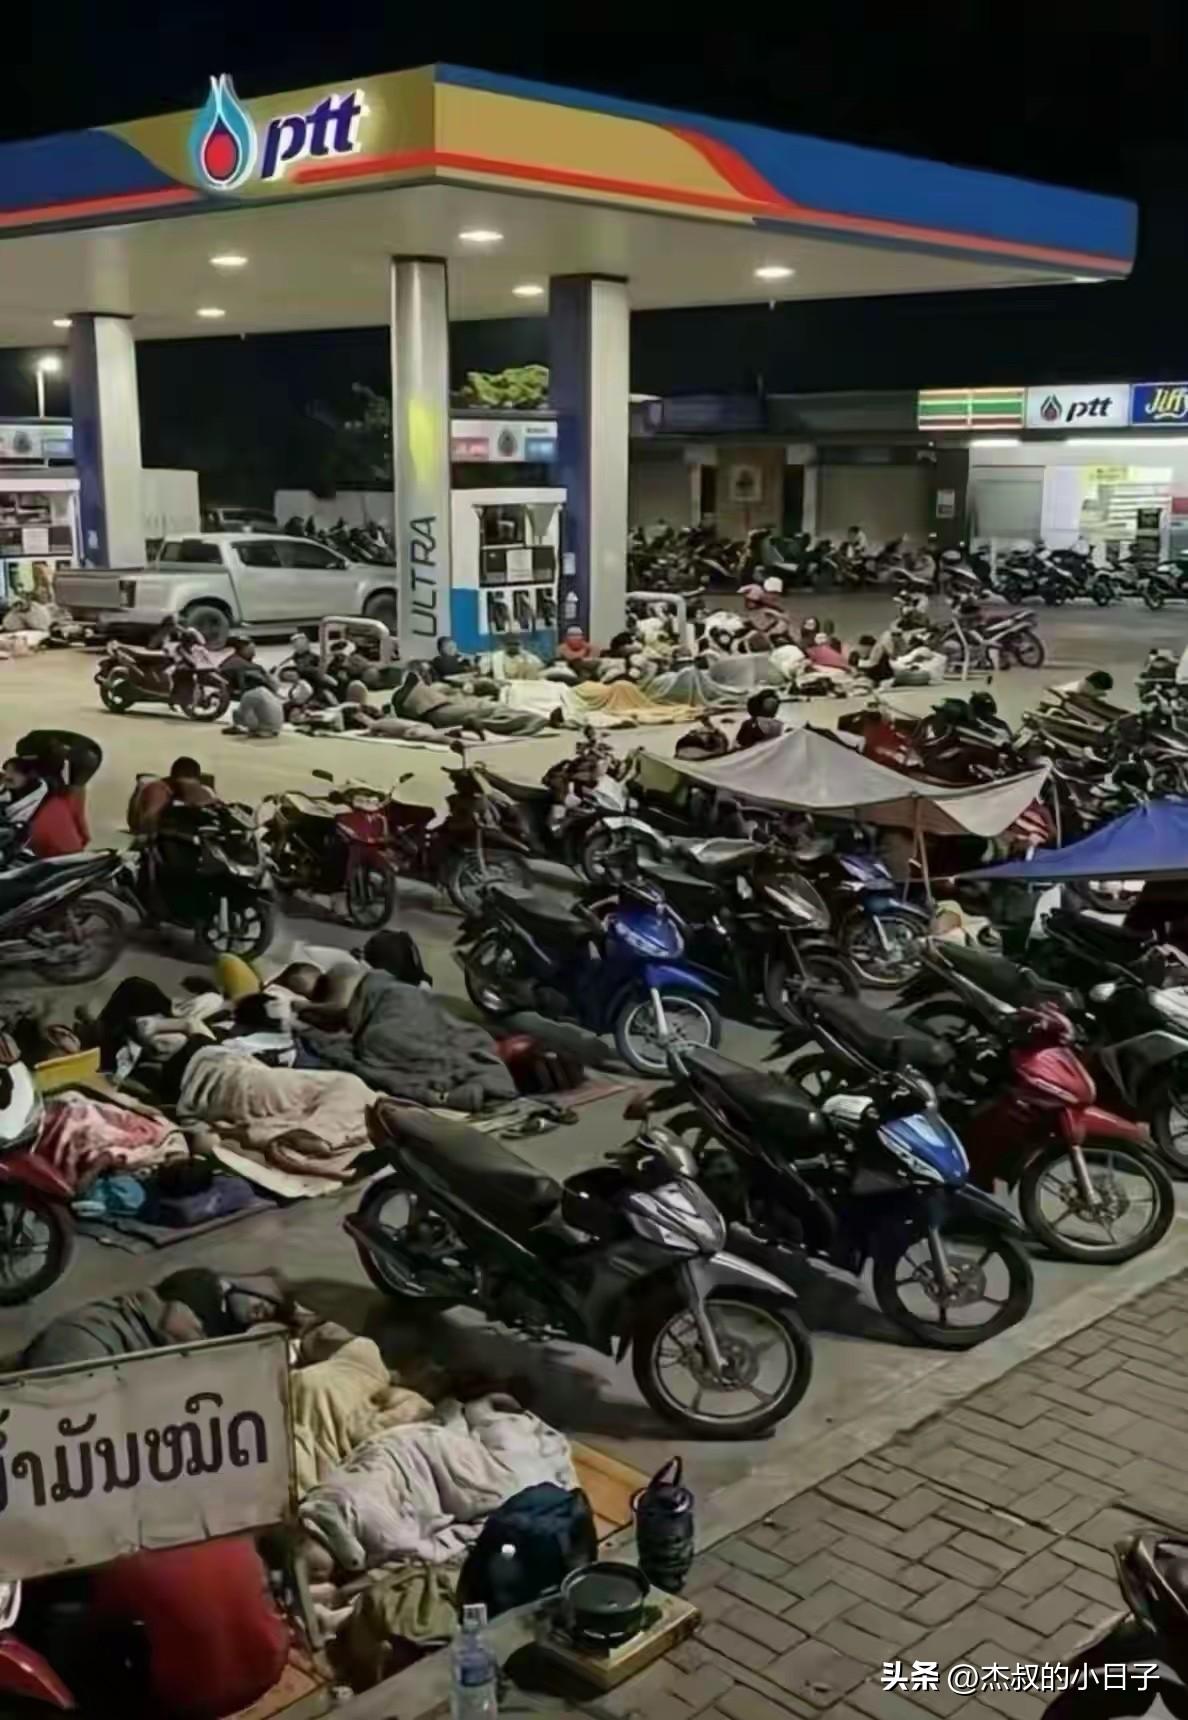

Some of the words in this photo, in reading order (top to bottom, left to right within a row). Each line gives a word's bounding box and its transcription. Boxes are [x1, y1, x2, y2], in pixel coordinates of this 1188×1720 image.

[261, 89, 371, 182] ptt
[1066, 396, 1112, 422] ptt
[410, 515, 438, 638] ULTRA
